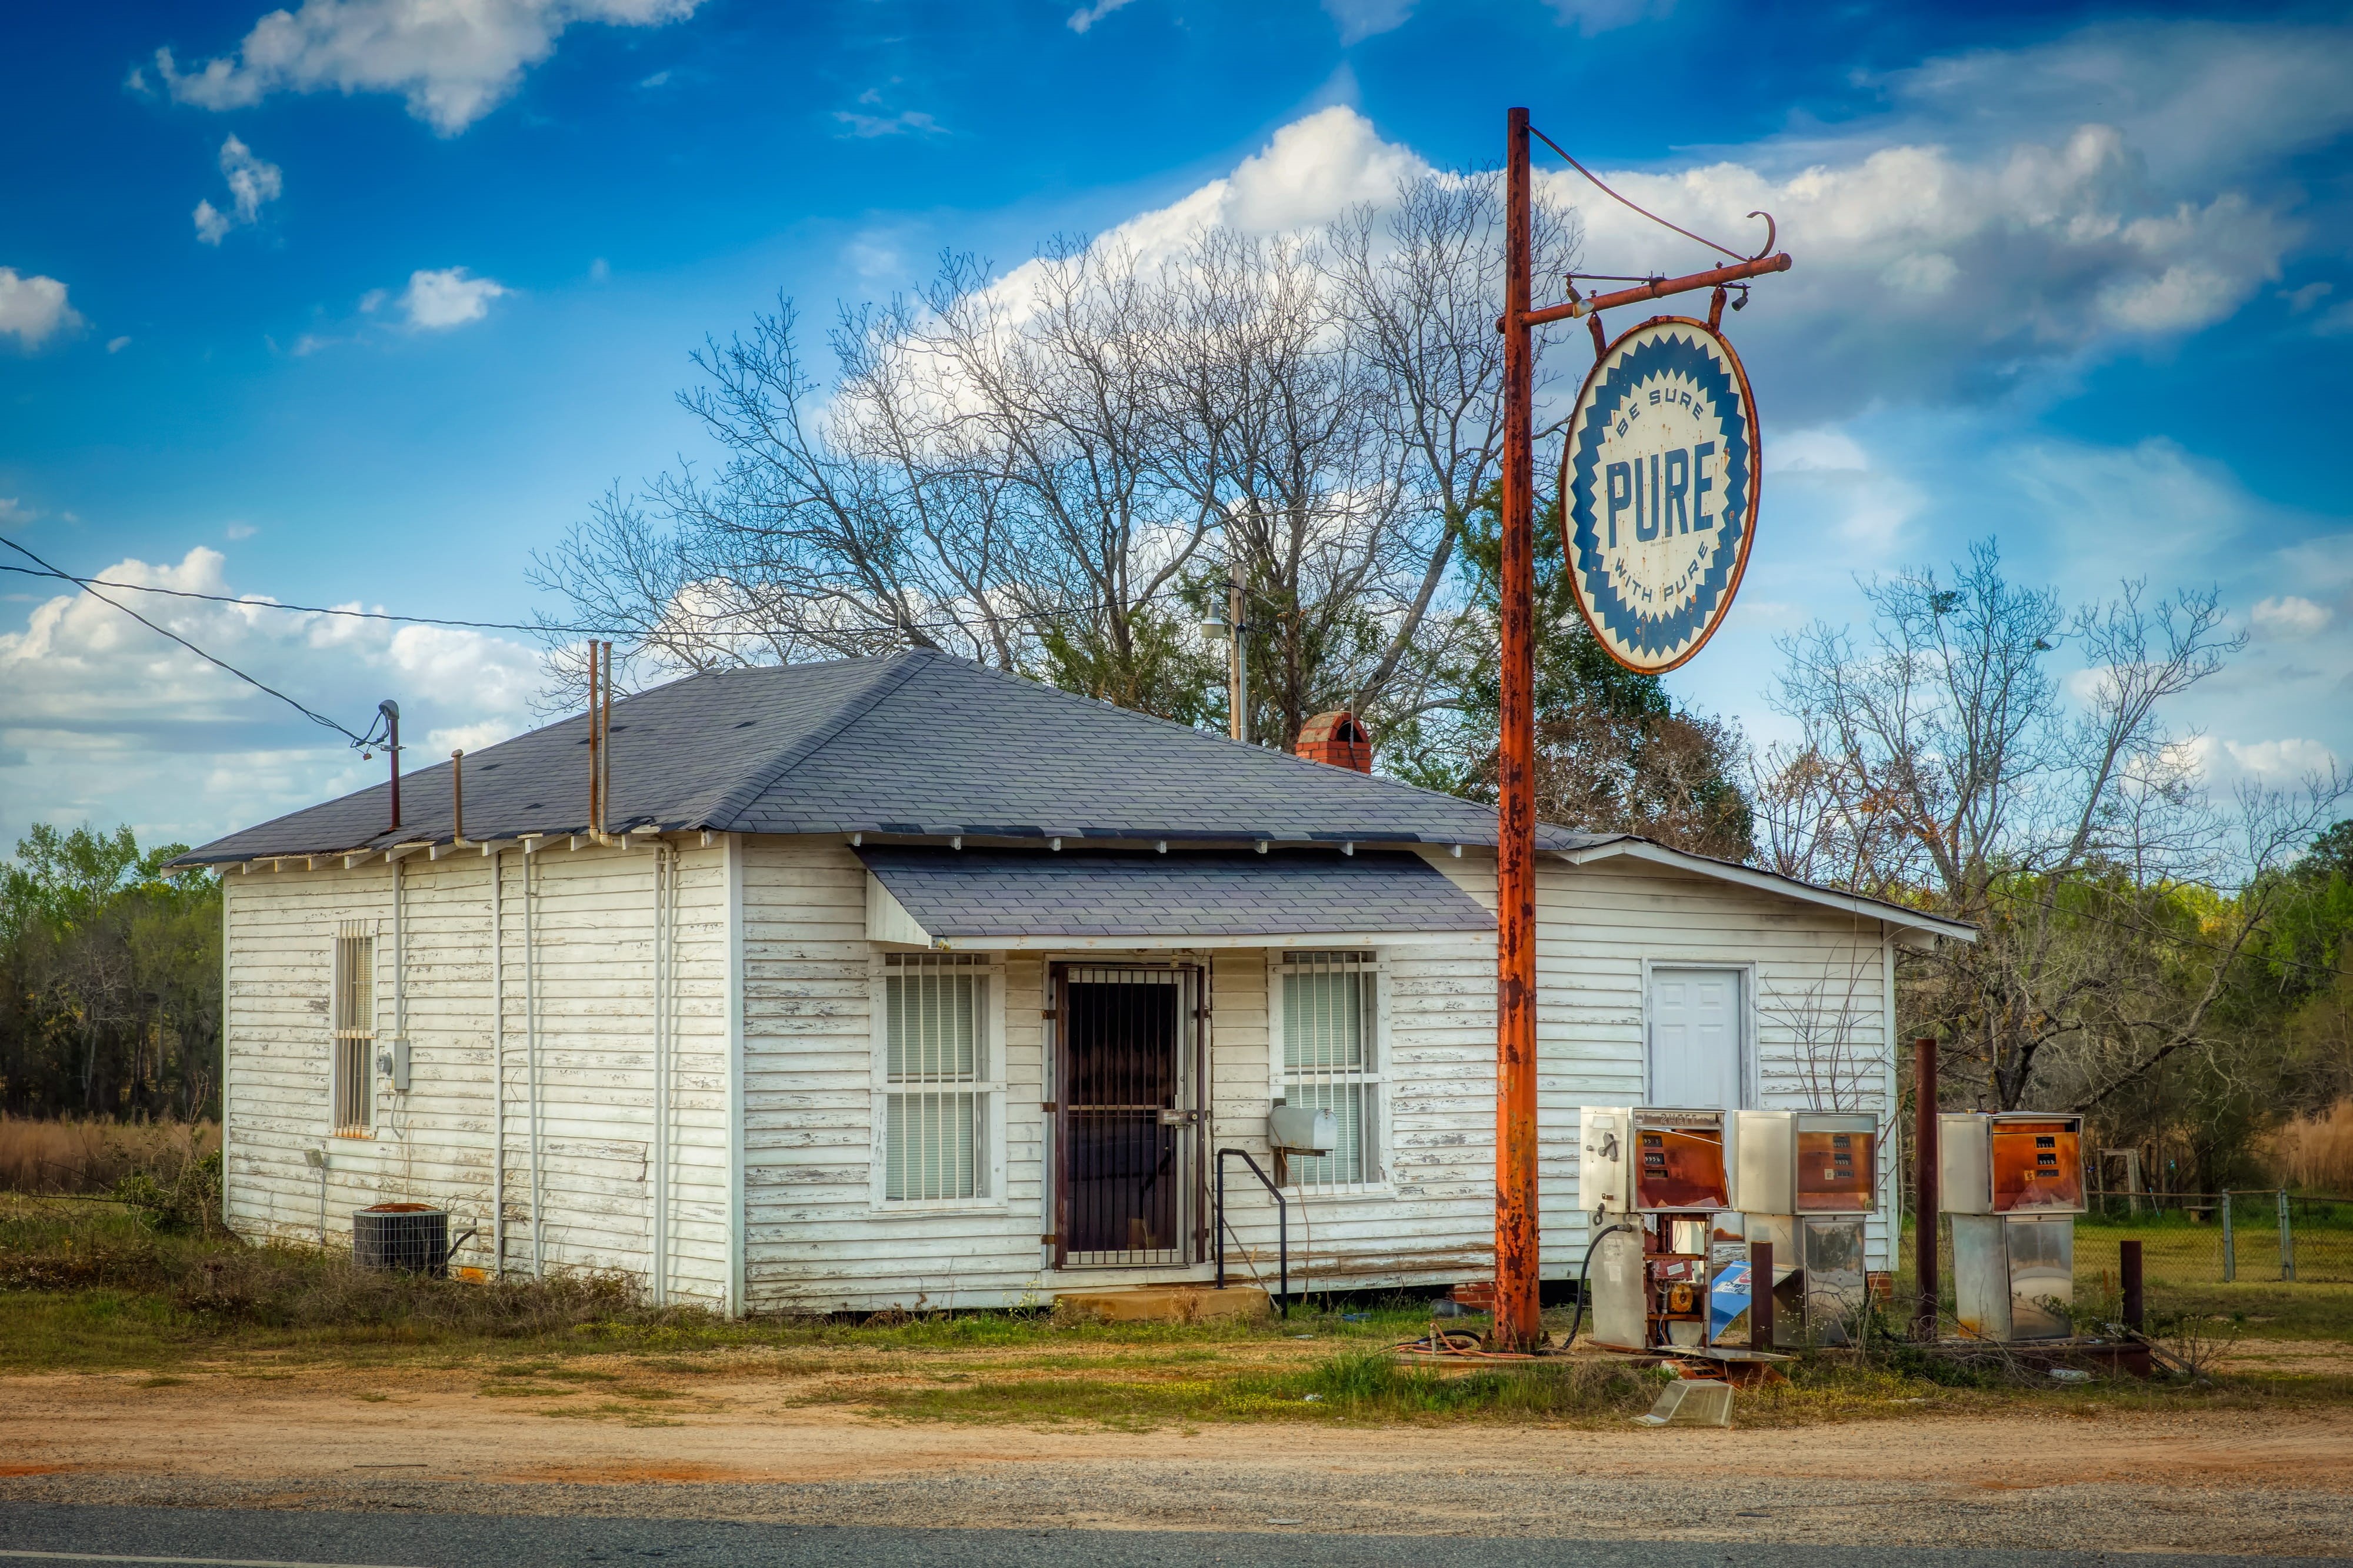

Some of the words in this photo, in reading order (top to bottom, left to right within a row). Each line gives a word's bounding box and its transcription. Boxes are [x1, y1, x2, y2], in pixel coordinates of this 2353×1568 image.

[1616, 402, 1641, 438] BE
[1649, 388, 1704, 421] SURE
[1606, 441, 1715, 549] PURE
[1614, 556, 1653, 603] WITH
[1664, 541, 1708, 602] PURE
